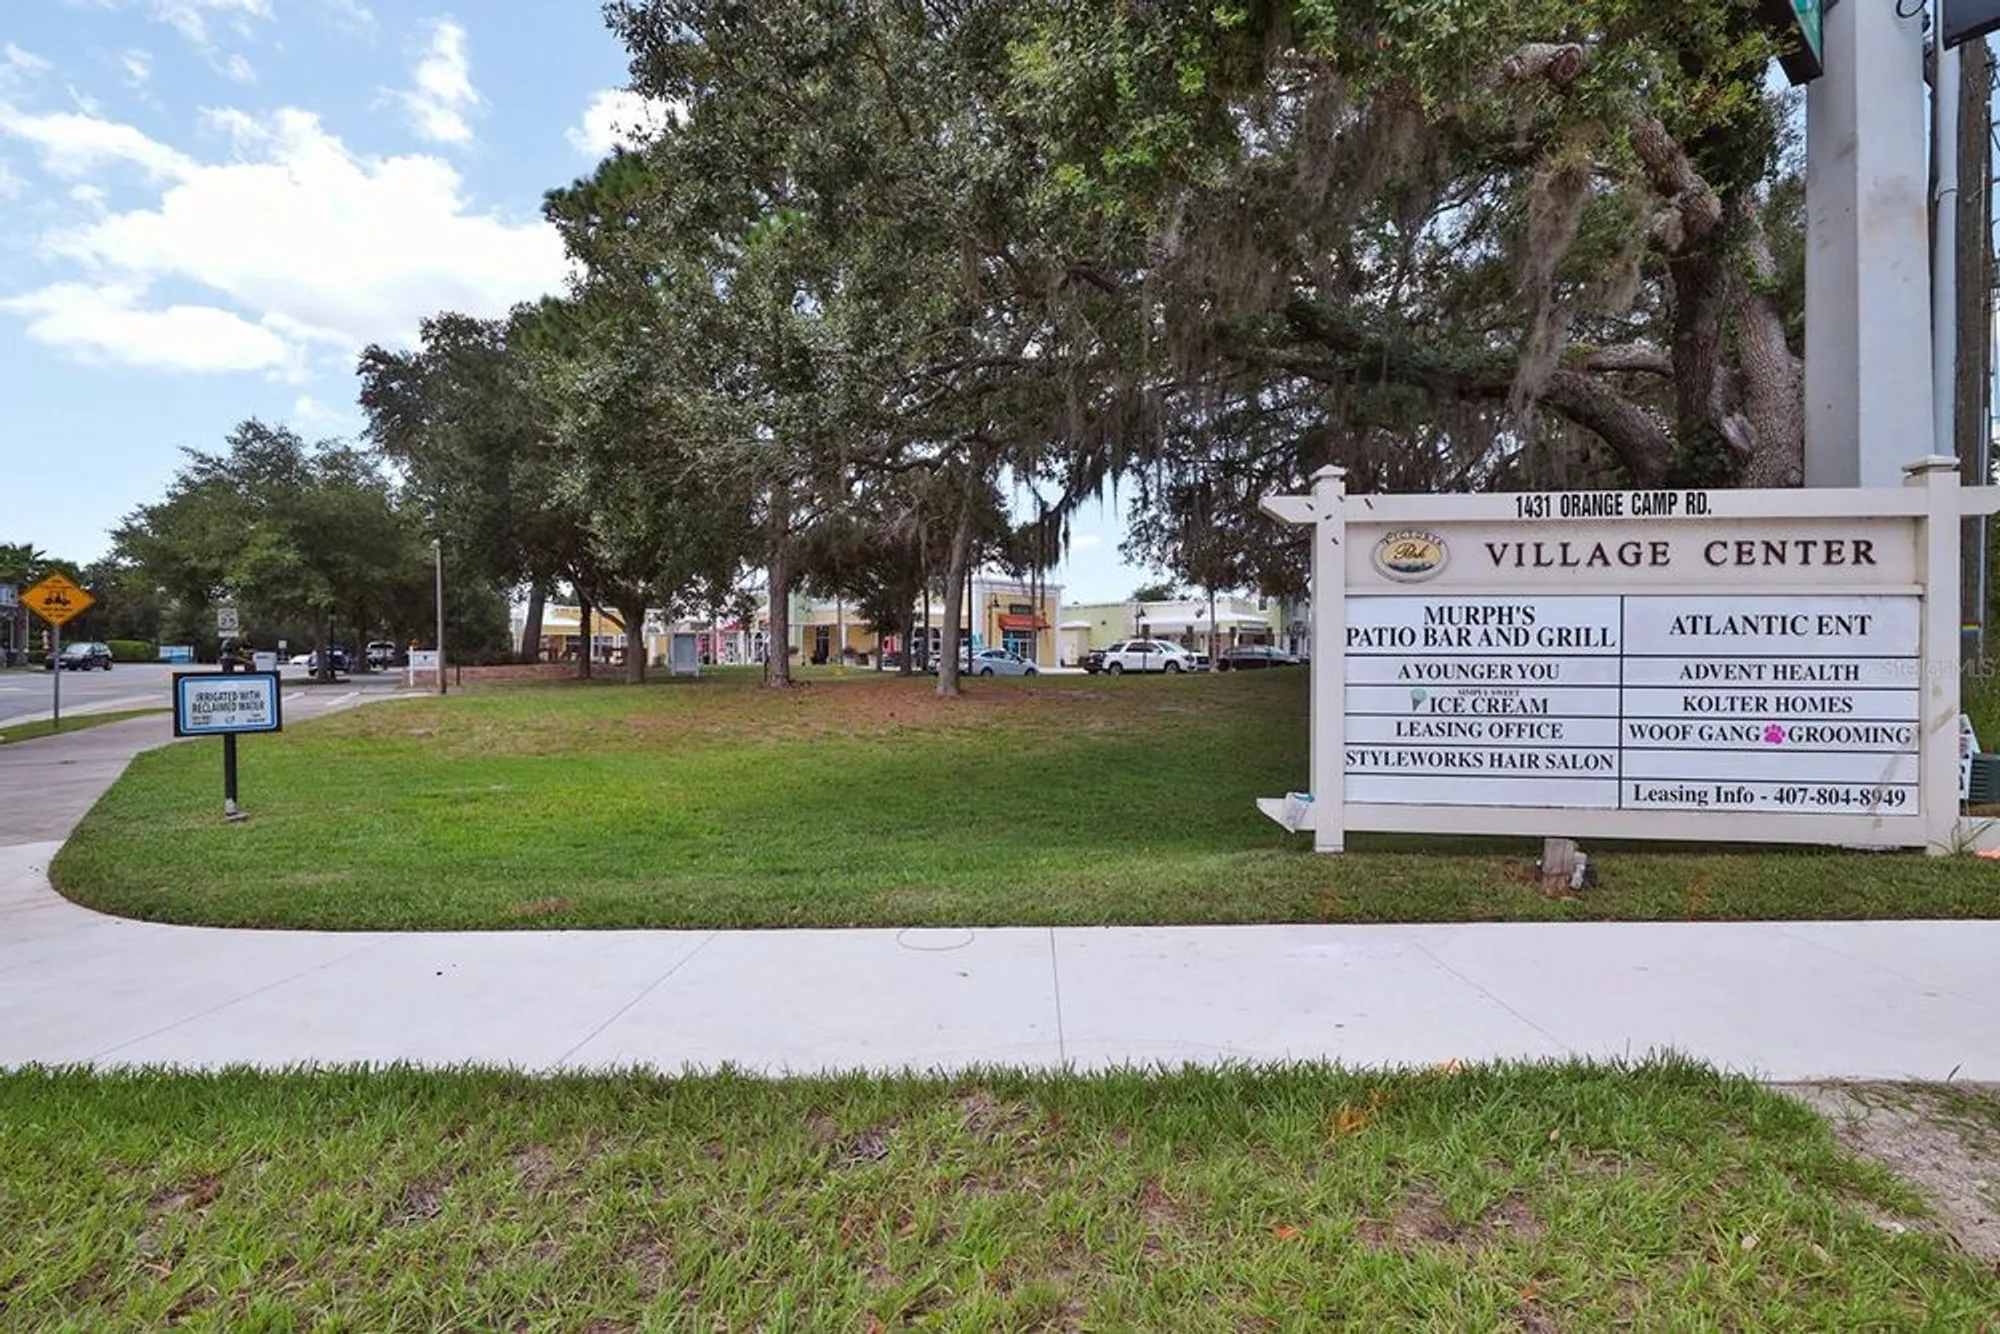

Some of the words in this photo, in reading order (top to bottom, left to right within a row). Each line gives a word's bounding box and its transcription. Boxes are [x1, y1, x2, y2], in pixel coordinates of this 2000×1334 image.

[1516, 496, 1550, 518] 1431
[1560, 494, 1623, 517] ORANGE
[1631, 492, 1678, 516] CAMP
[1686, 492, 1712, 515] RD.
[1485, 541, 1671, 567] VILLAGE
[1704, 540, 1877, 565] CENTER
[1424, 605, 1536, 626] MURPH'S
[1669, 614, 1809, 636] ATLANTIC
[1817, 615, 1872, 636] ENT
[1346, 627, 1417, 648] PATIO
[1423, 627, 1472, 647] BAR
[1477, 627, 1530, 647] AND
[1536, 626, 1616, 648] GRILL
[1397, 664, 1411, 680] A
[1414, 664, 1513, 681] YOUNGER
[1517, 664, 1560, 681] YOU
[1679, 664, 1767, 681] ADVENT
[1773, 665, 1860, 681] HEALTH
[1430, 698, 1465, 714] ICE
[1471, 698, 1549, 714] CREAM
[1683, 696, 1768, 713] KOLTER
[1775, 696, 1854, 713] HOMES
[1395, 721, 1483, 738] LEASING
[1488, 722, 1563, 739] OFFICE
[1629, 724, 1693, 741] WOOF
[1699, 724, 1761, 742] GANG
[1788, 725, 1911, 744] GROOMING
[1345, 749, 1484, 768] STYLEWORKS
[1489, 751, 1541, 769] HAIR
[1545, 752, 1614, 770] SALON
[1633, 784, 1708, 806] Leasing
[1714, 786, 1755, 803] Info
[1773, 787, 1906, 807] 407-804-8949
